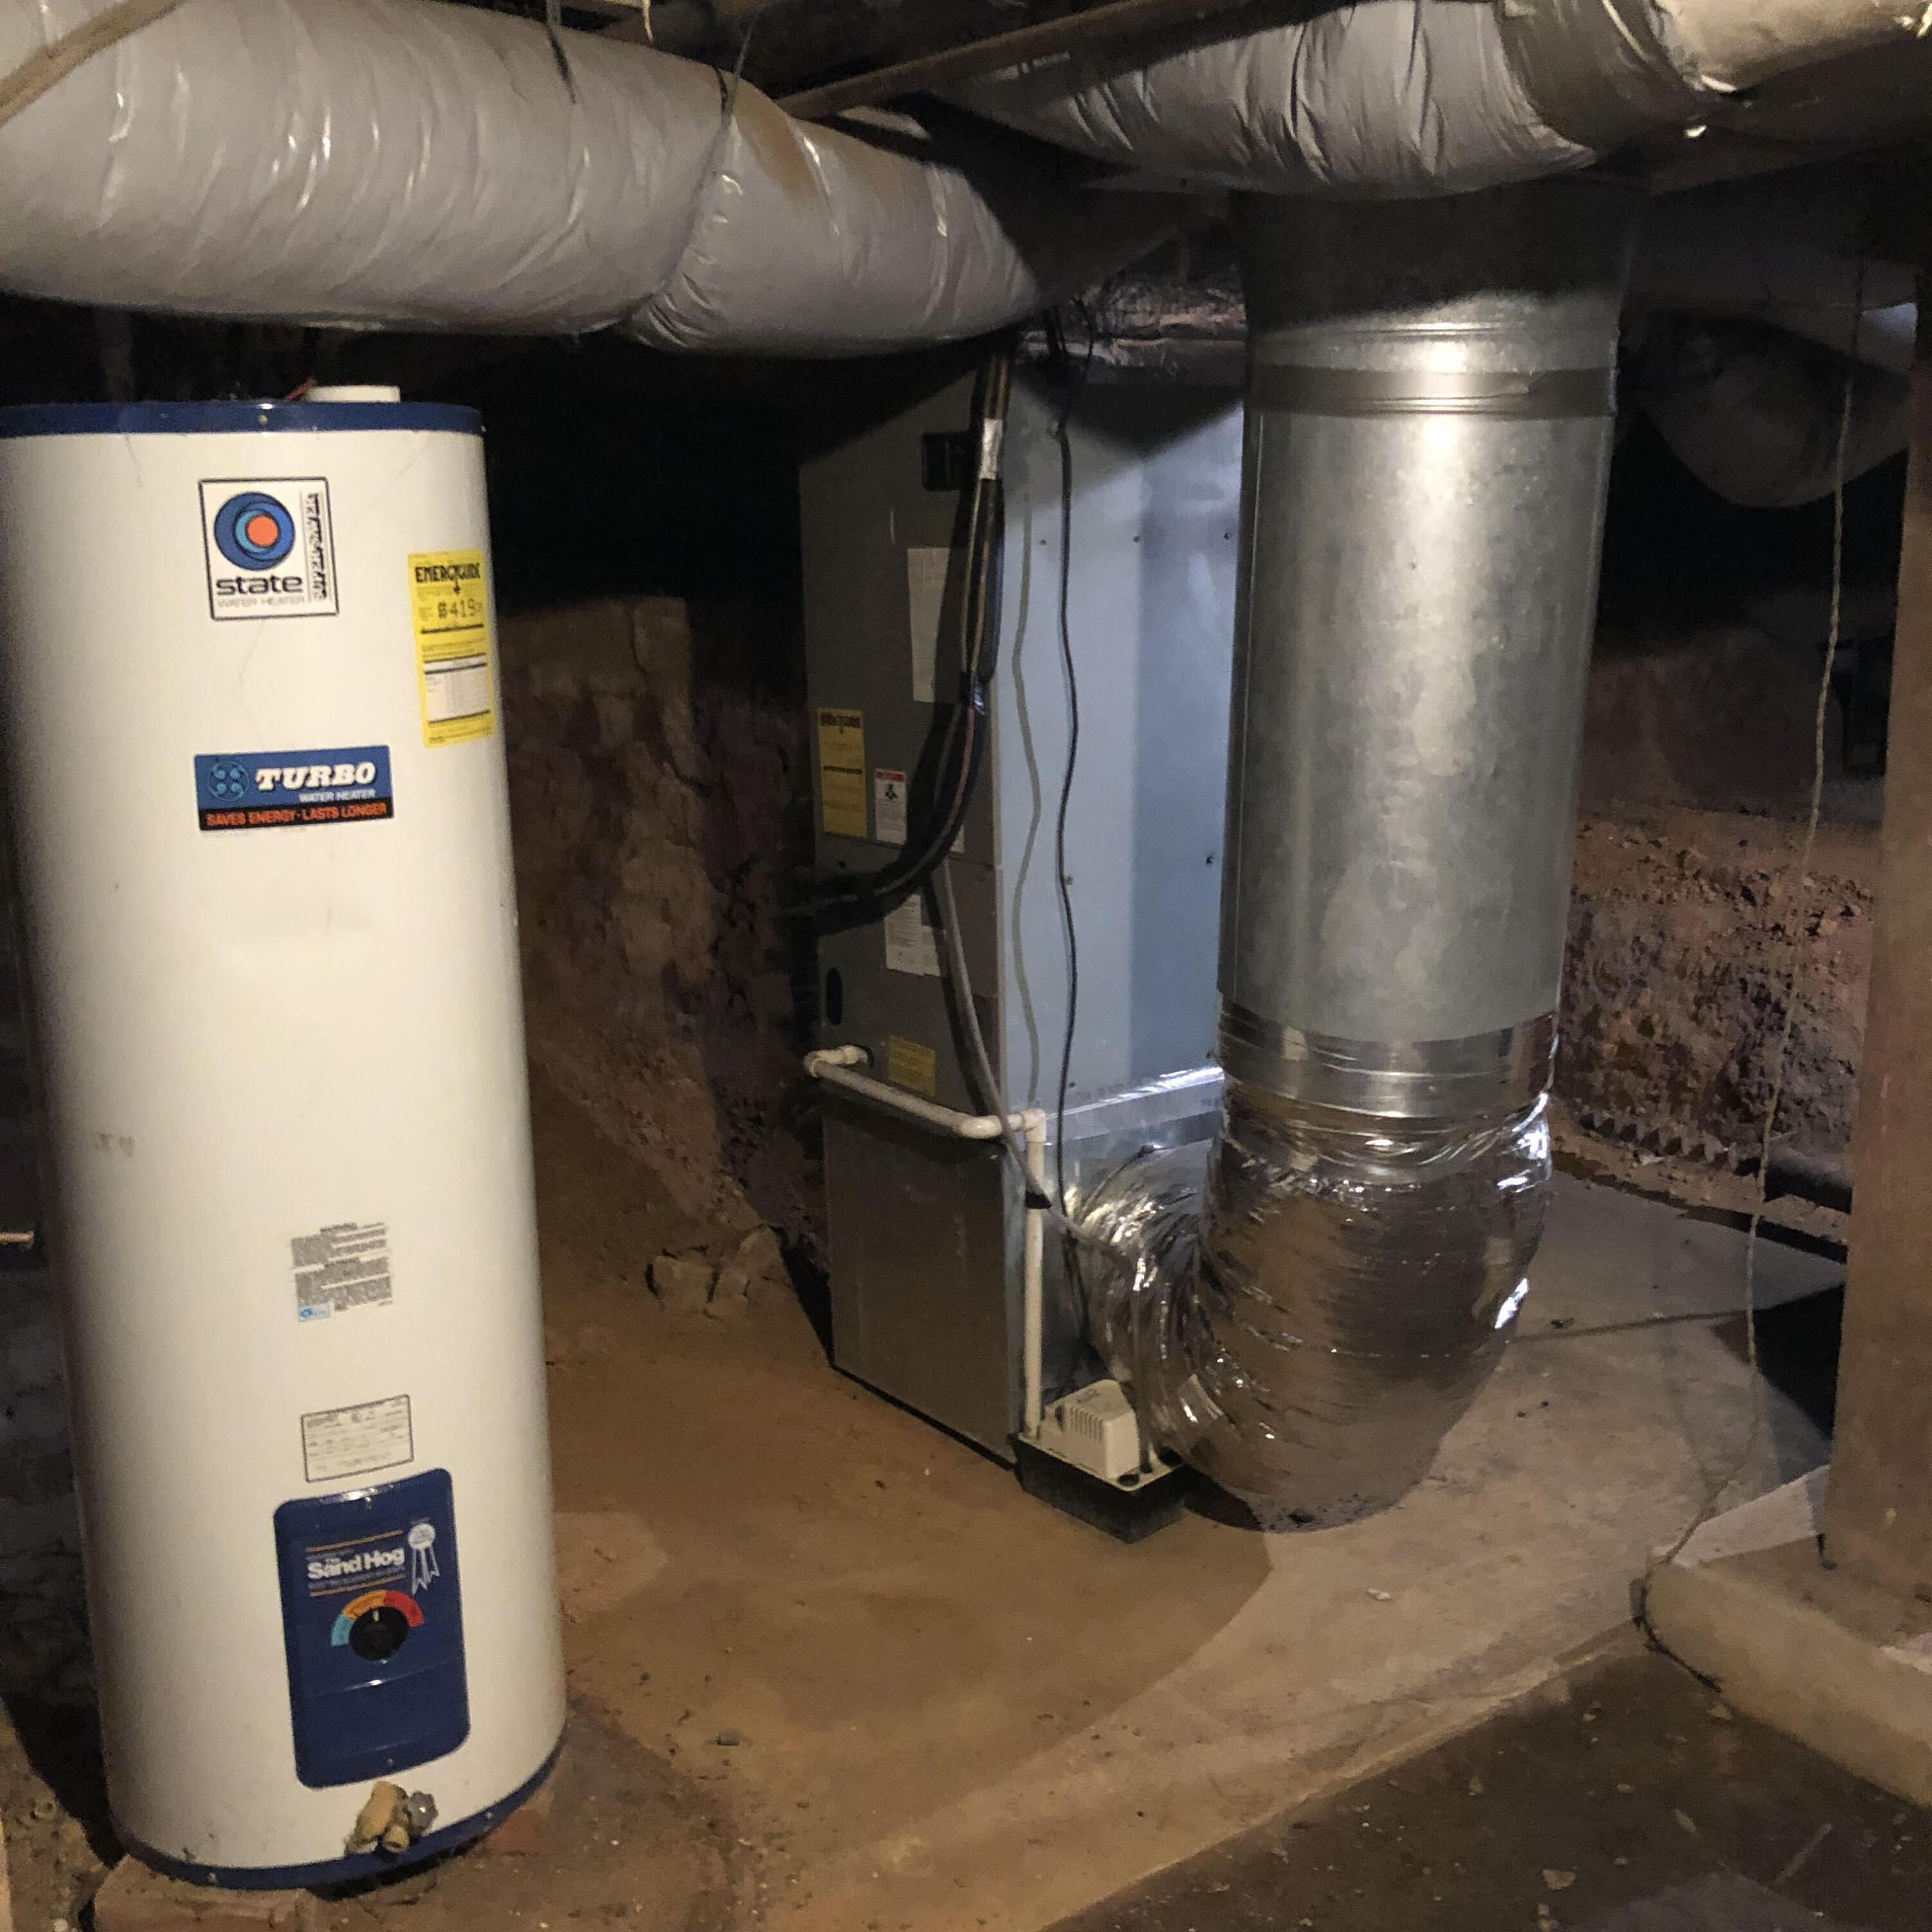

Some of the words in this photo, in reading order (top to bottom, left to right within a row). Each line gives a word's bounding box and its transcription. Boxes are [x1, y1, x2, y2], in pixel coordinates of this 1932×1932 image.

[216, 576, 303, 596] state
[256, 762, 376, 791] TURBO
[206, 812, 246, 826] SAVES
[247, 810, 296, 824] ENERGY
[301, 806, 339, 821] LASTS
[341, 802, 386, 818] LONGER
[307, 1554, 363, 1579] Sand
[364, 1547, 405, 1570] Hog
